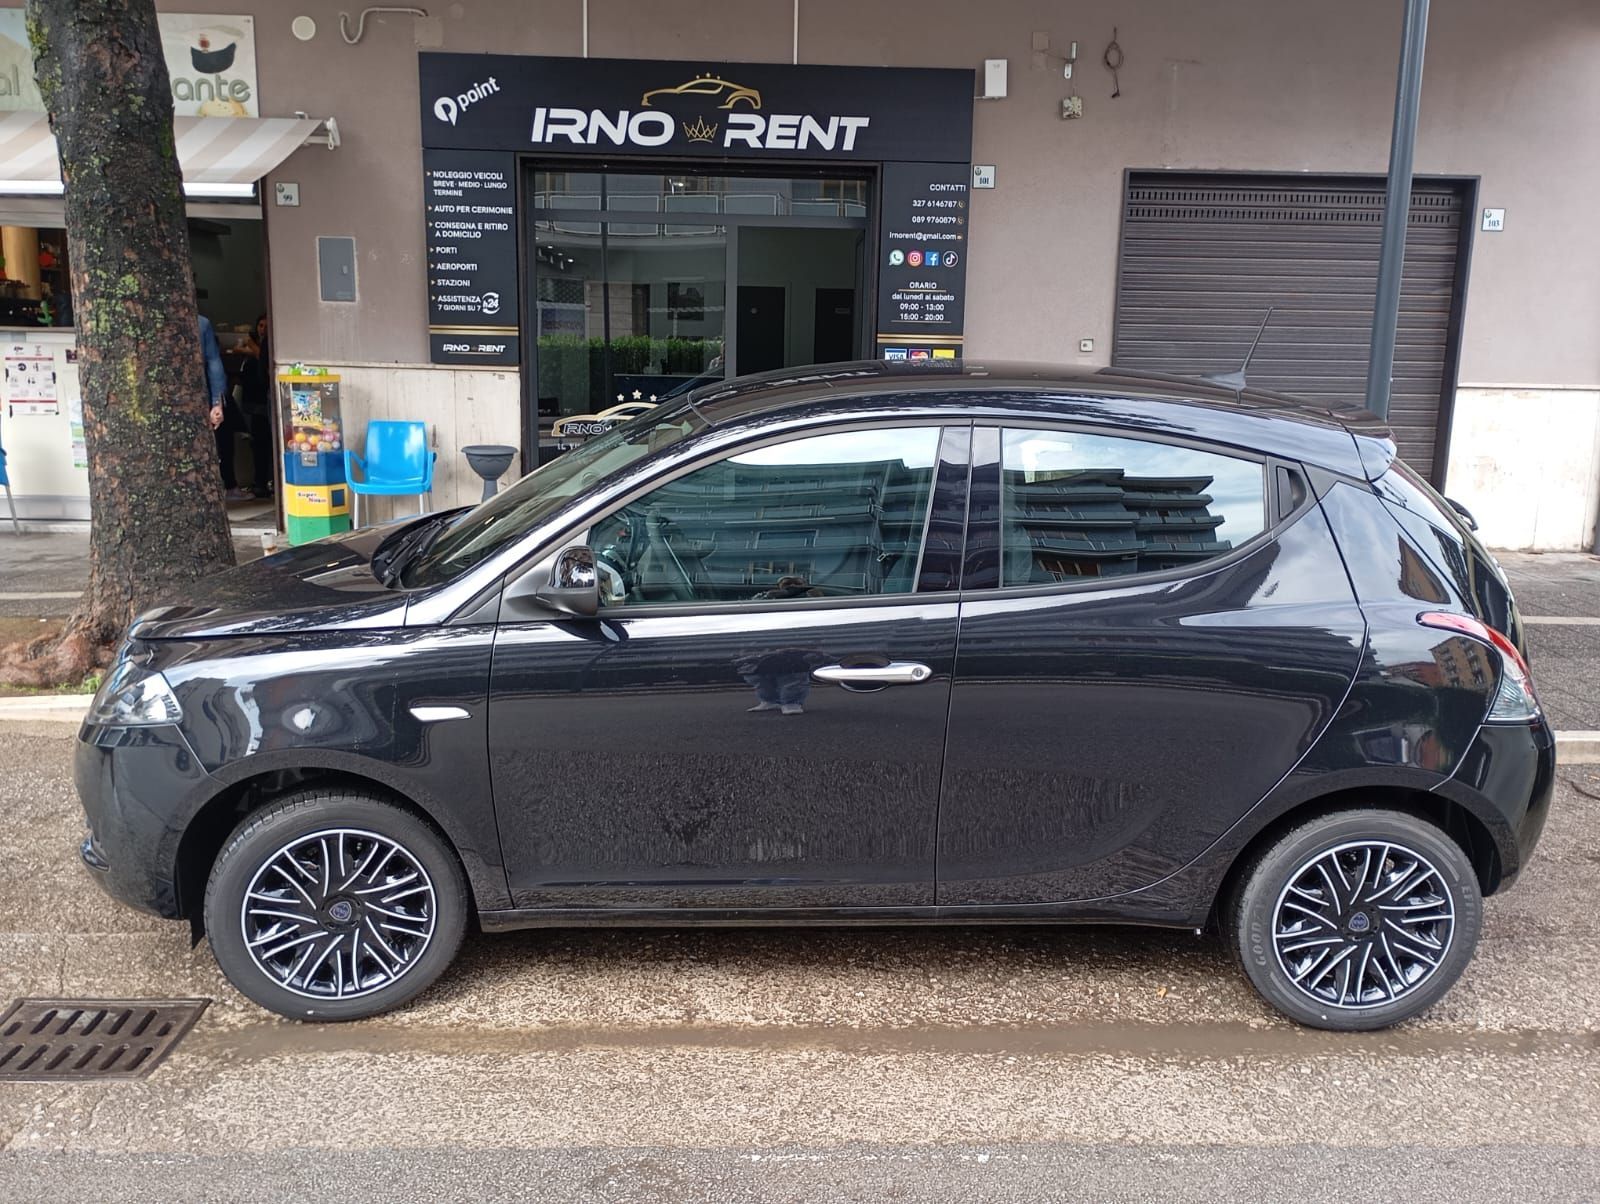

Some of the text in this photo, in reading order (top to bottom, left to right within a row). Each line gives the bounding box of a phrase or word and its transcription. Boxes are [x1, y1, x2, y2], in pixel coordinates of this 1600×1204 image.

[531, 107, 870, 151] IRNO RENT
[433, 171, 503, 180] NOLEGGIO VEICOLI
[929, 184, 966, 192] CONTATTI
[927, 200, 957, 208] 6146787
[434, 205, 513, 215] AUTO PER CERIMONIE
[927, 216, 957, 224] 9760879
[434, 221, 476, 230] CONSEGNA
[484, 223, 508, 231] RITIRO
[435, 230, 482, 238] A DOMICILIO
[435, 246, 458, 254] PORTI
[436, 262, 478, 271] AEROPORTI
[437, 279, 471, 287] STAZIONI
[909, 281, 937, 289] ORARIO
[437, 295, 481, 303] ASSISTENZA
[891, 293, 903, 301] dal
[924, 293, 932, 301] al
[932, 294, 955, 302] sabato
[899, 303, 920, 311] 09:00
[443, 343, 506, 353] IRNO RENT
[564, 423, 605, 435] IRNO
